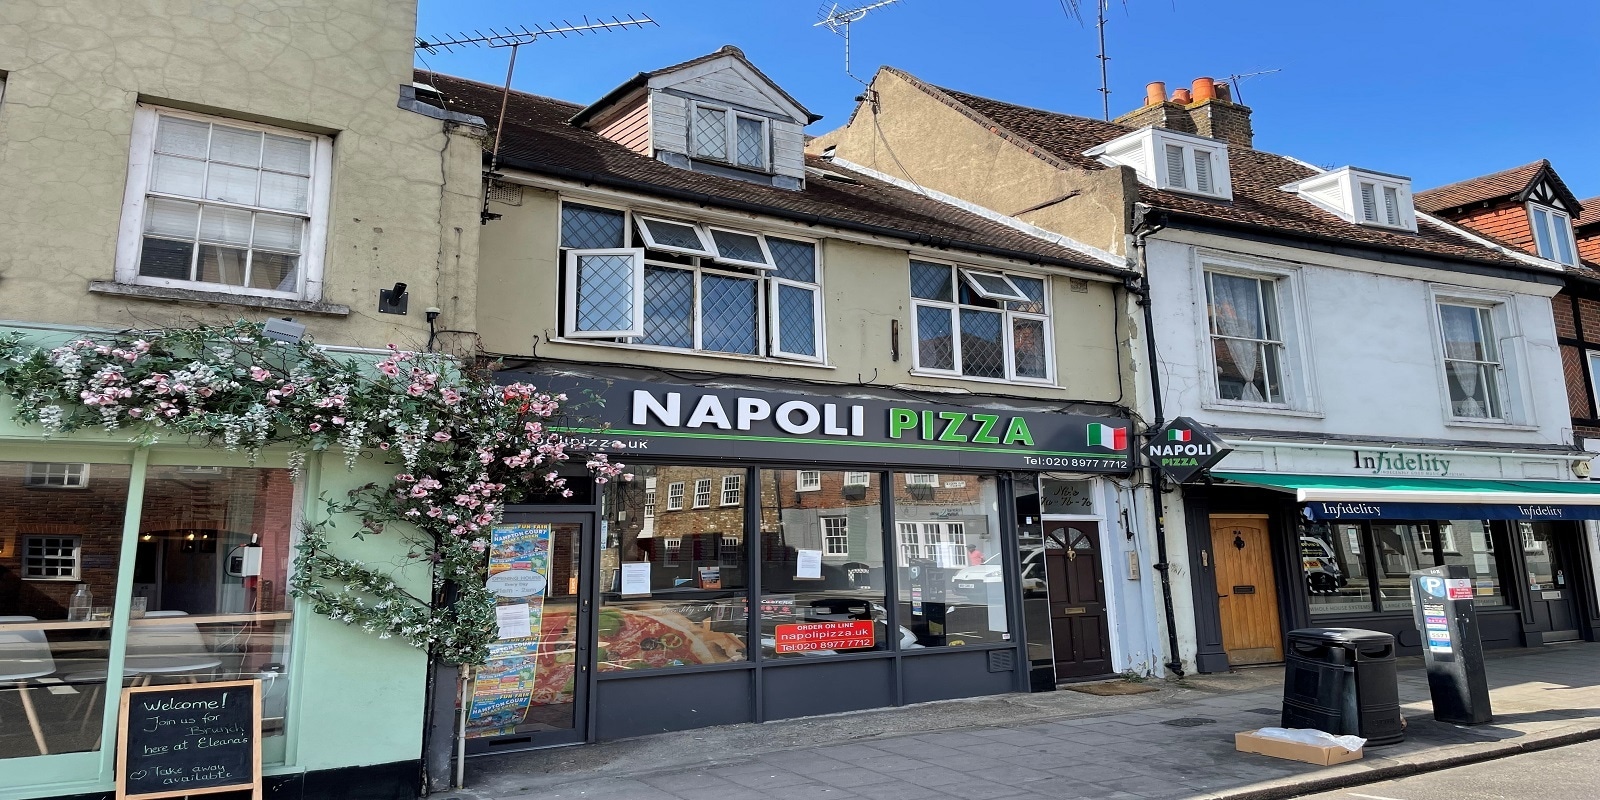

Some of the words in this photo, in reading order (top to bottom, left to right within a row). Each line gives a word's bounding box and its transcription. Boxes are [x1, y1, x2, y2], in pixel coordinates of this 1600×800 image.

[632, 389, 865, 436] NAPOLI
[889, 407, 1035, 446] PIZZA
[1149, 444, 1212, 456] NAPOLI
[1023, 456, 1068, 466] Tel:020
[1071, 458, 1099, 467] 8977
[1102, 460, 1127, 469] 7712
[1161, 457, 1199, 467] PIZZA
[1353, 450, 1451, 476] Infidelity
[1321, 502, 1381, 518] Infidelity
[1517, 505, 1563, 519] Infidelity
[494, 531, 525, 542] HAMPTON
[781, 628, 869, 640] napolipizza.uk
[780, 642, 817, 652] Tel:020
[820, 640, 845, 649] 8977
[847, 638, 871, 647] 7712
[143, 692, 228, 711] Welcome!
[472, 702, 505, 715] HAMPTON
[505, 697, 528, 705] COURT
[143, 716, 176, 733] Join
[202, 712, 220, 724] for
[144, 744, 169, 754] here
[173, 740, 189, 751] at
[150, 765, 183, 777] Take
[192, 763, 226, 774] away
